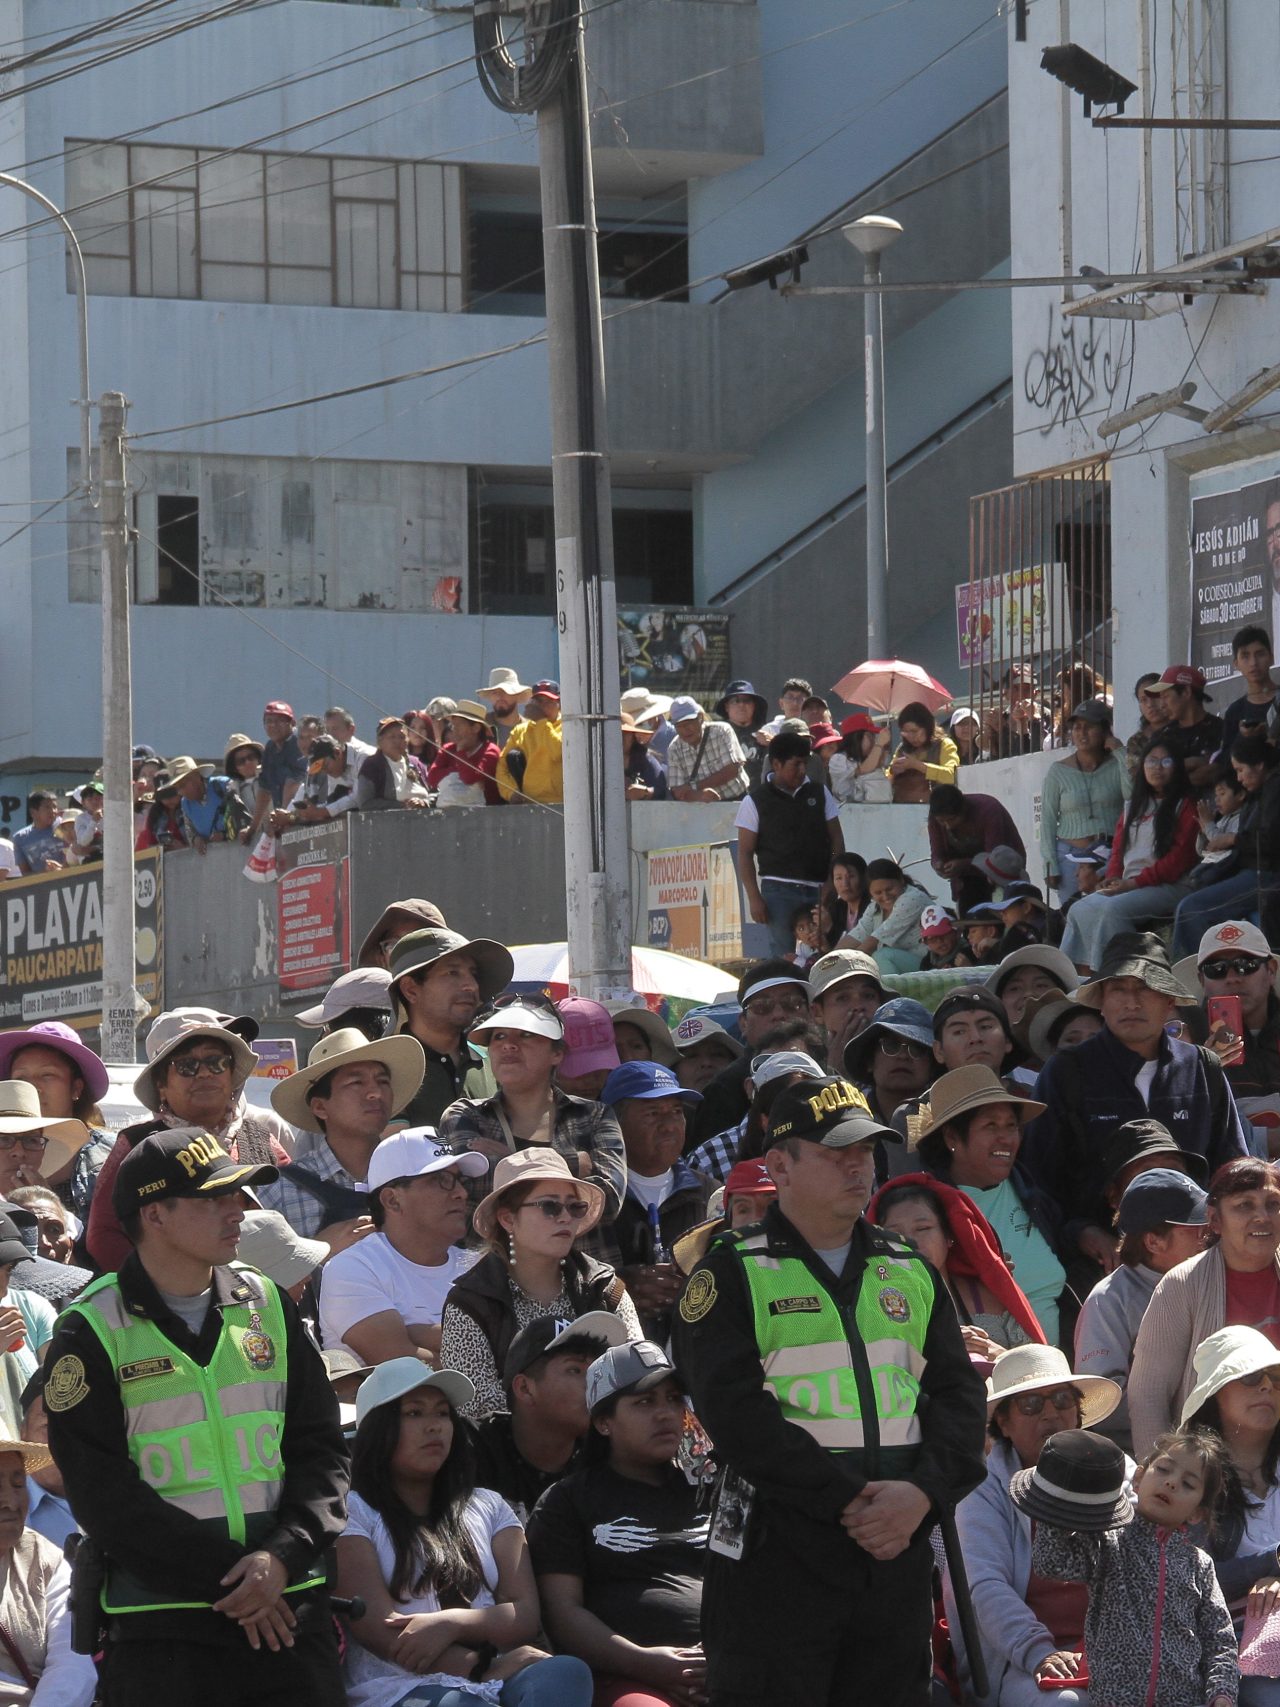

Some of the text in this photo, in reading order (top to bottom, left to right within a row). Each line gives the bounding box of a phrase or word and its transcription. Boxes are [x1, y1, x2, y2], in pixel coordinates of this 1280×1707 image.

[1195, 526, 1224, 553] JESÚS
[1219, 602, 1229, 623] 30
[648, 852, 709, 886] FOTOCOPIADORA
[658, 886, 698, 905] MARCOPOLO
[6, 880, 104, 956] PLAYA
[7, 943, 105, 986] PAUCARPATA
[773, 1121, 793, 1137] PERU
[137, 1178, 167, 1196] PERU
